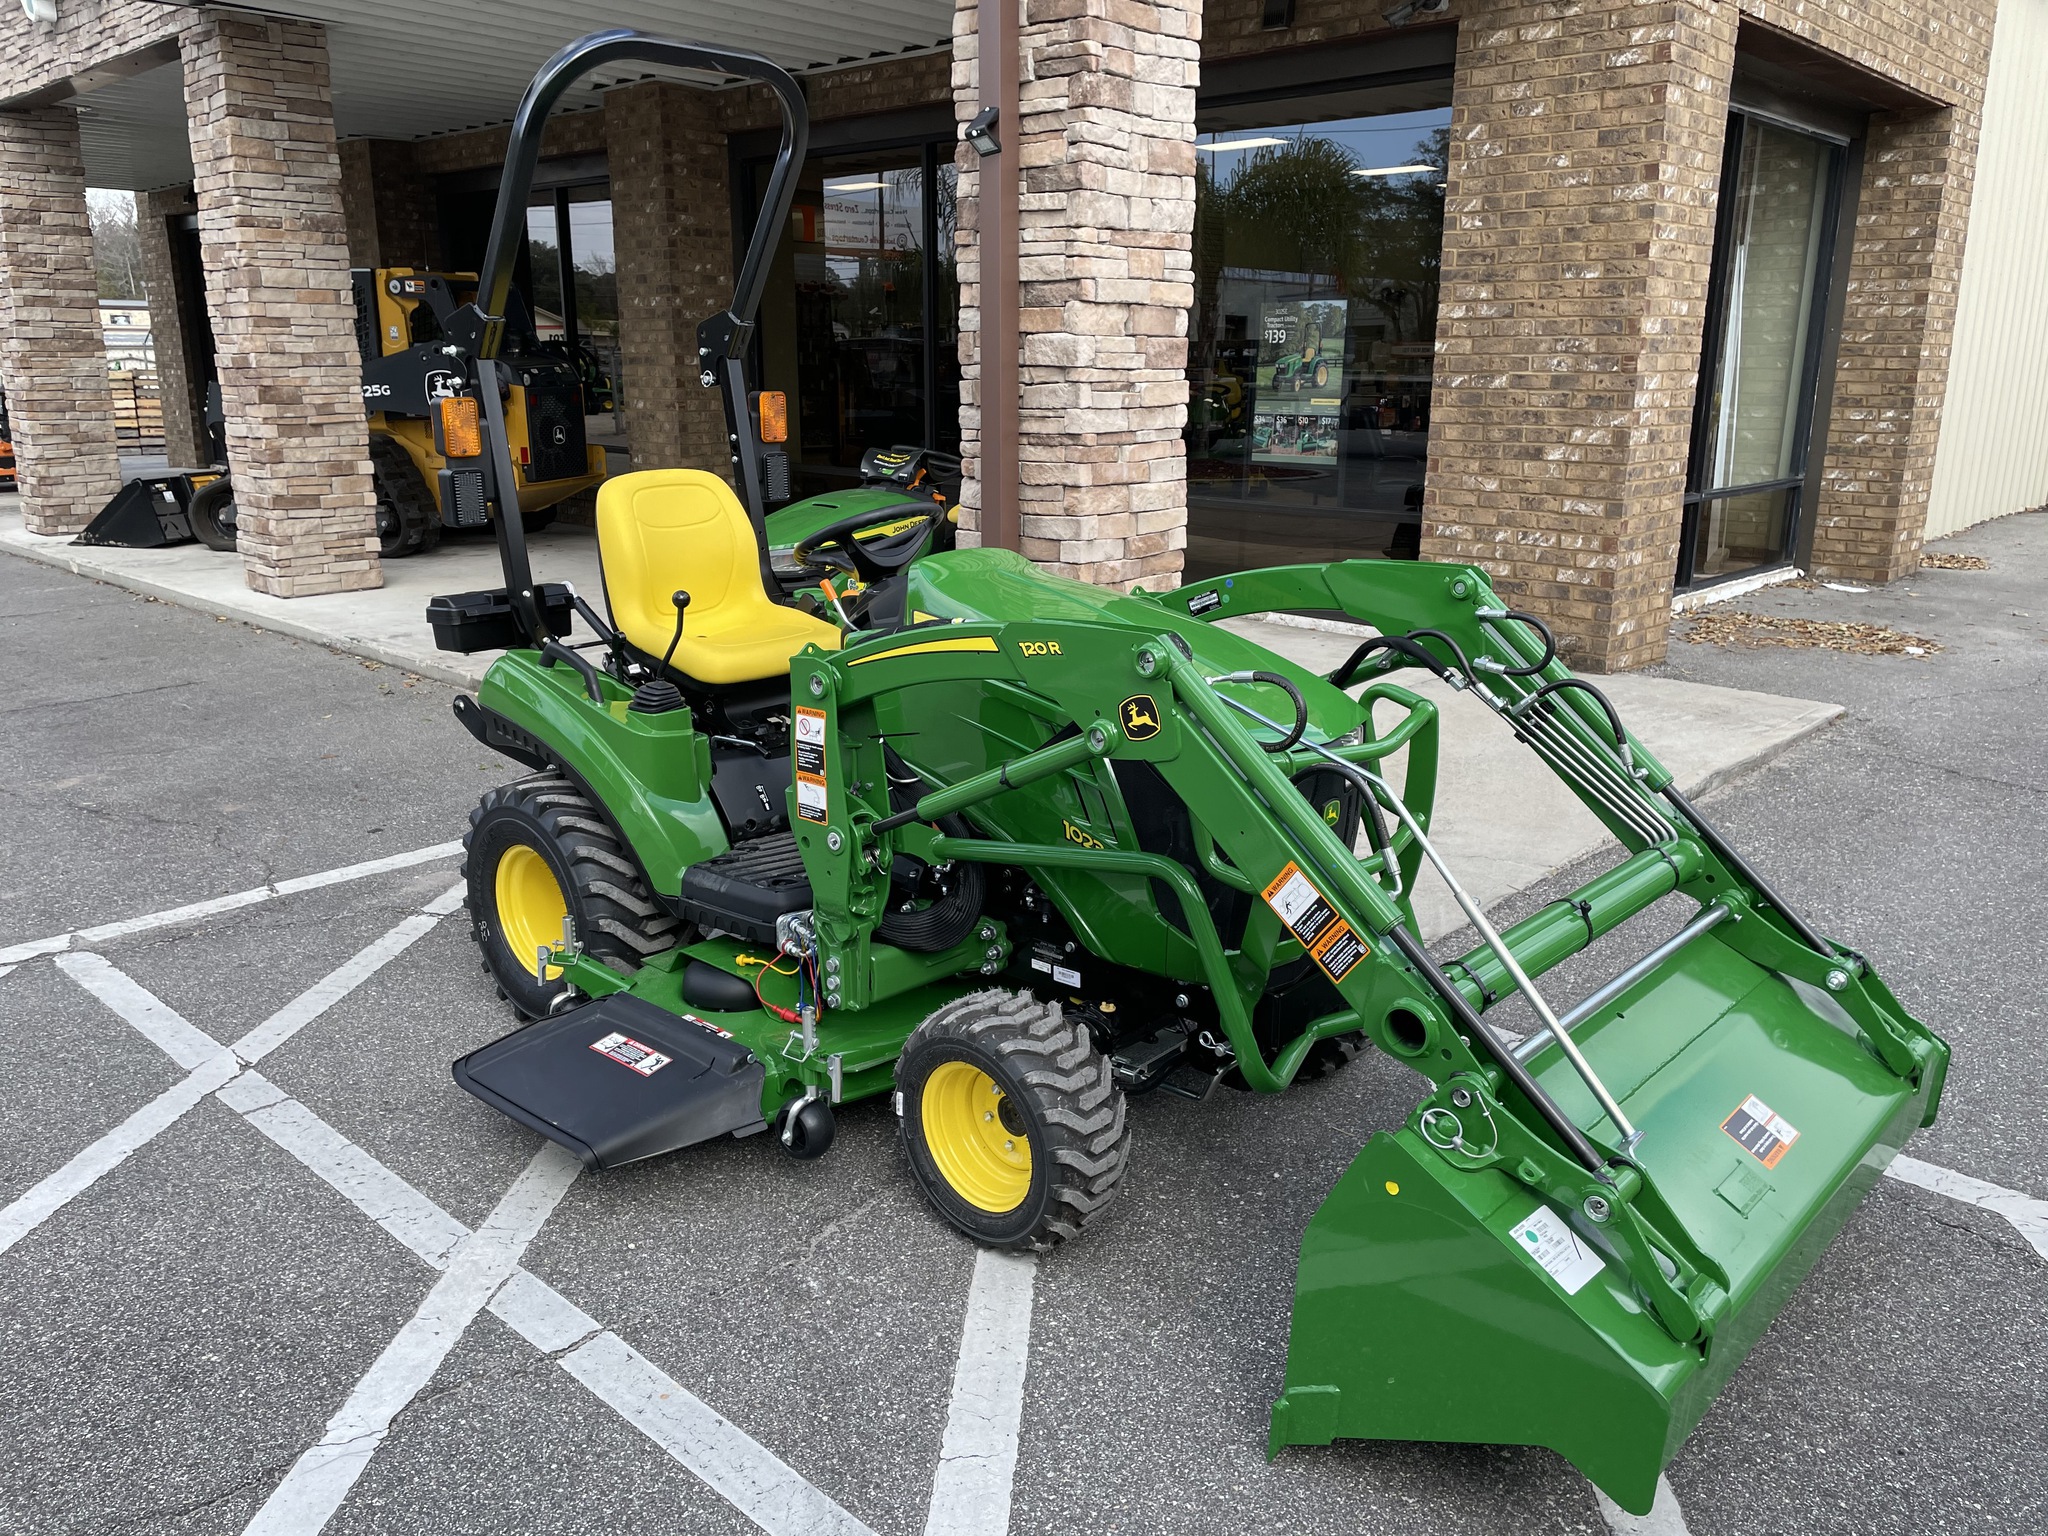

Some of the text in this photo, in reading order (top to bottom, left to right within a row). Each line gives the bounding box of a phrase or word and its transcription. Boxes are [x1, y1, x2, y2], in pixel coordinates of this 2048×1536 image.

[1284, 315, 1298, 323] Utility
[1264, 329, 1287, 344] $139
[361, 384, 391, 397] 25G
[1276, 416, 1288, 424] $36
[1298, 416, 1309, 425] $10
[892, 522, 909, 534] JOHN
[1271, 867, 1294, 892] WARNING
[1321, 925, 1345, 949] WARNING
